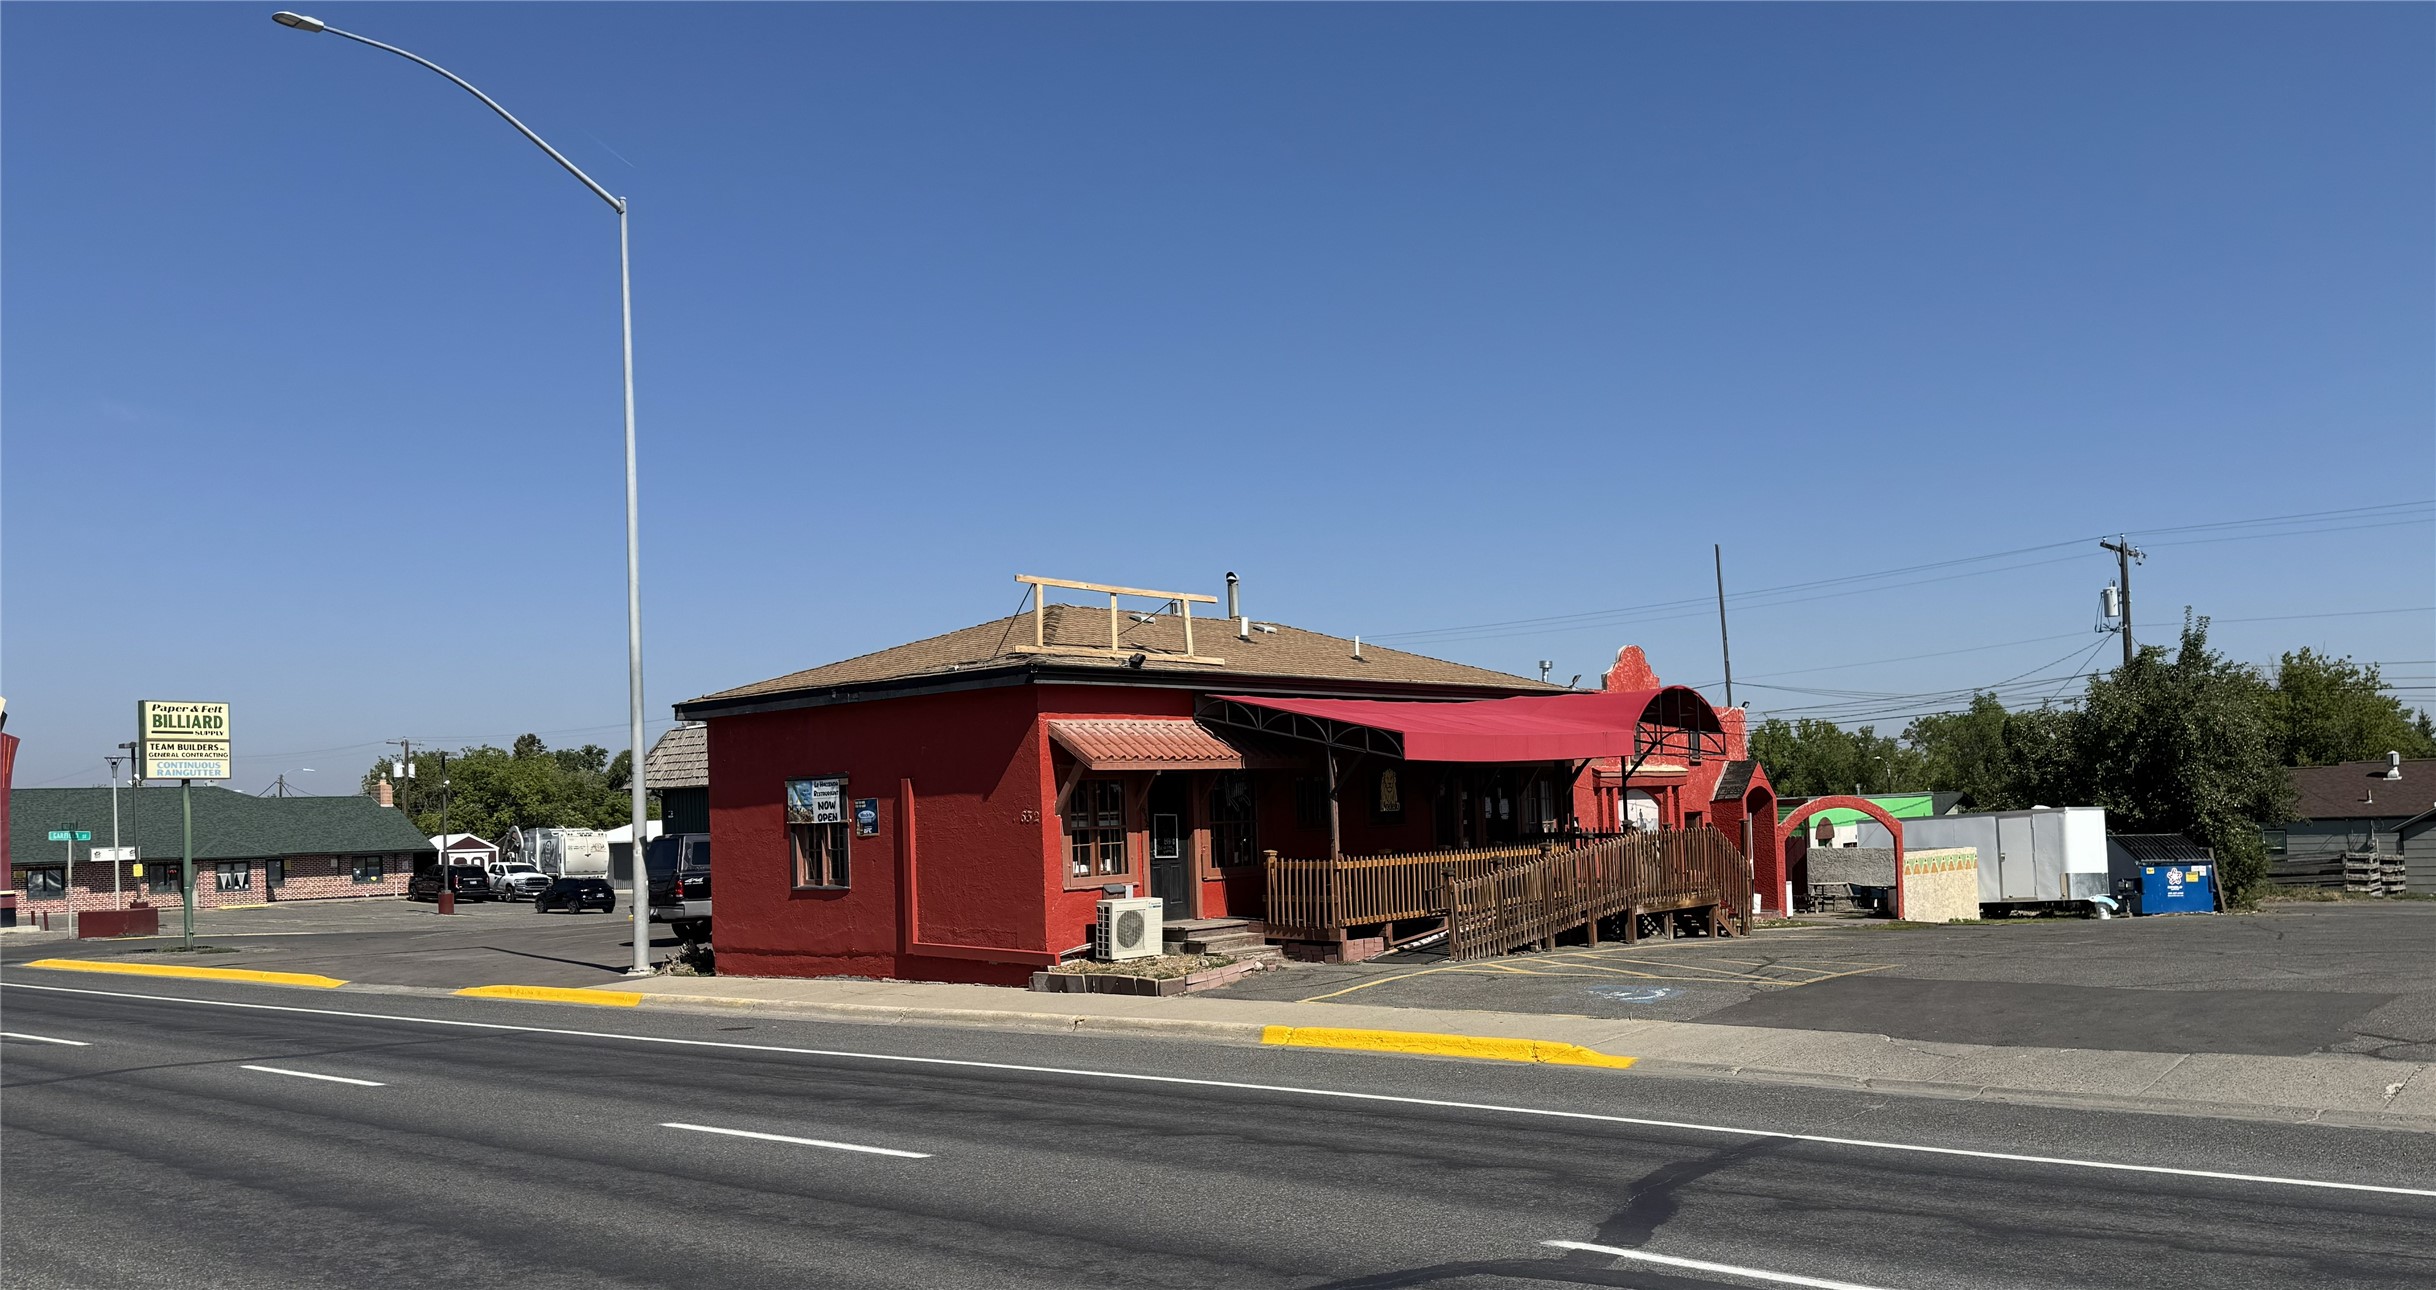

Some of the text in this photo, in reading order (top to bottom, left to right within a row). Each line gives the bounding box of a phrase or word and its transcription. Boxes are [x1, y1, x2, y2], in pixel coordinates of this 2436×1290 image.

[152, 704, 223, 713] Paper & Felt
[152, 714, 223, 728] BILLIARD
[177, 743, 219, 751] BUILDERS
[817, 801, 836, 810] NOW
[817, 812, 838, 822] OPEN
